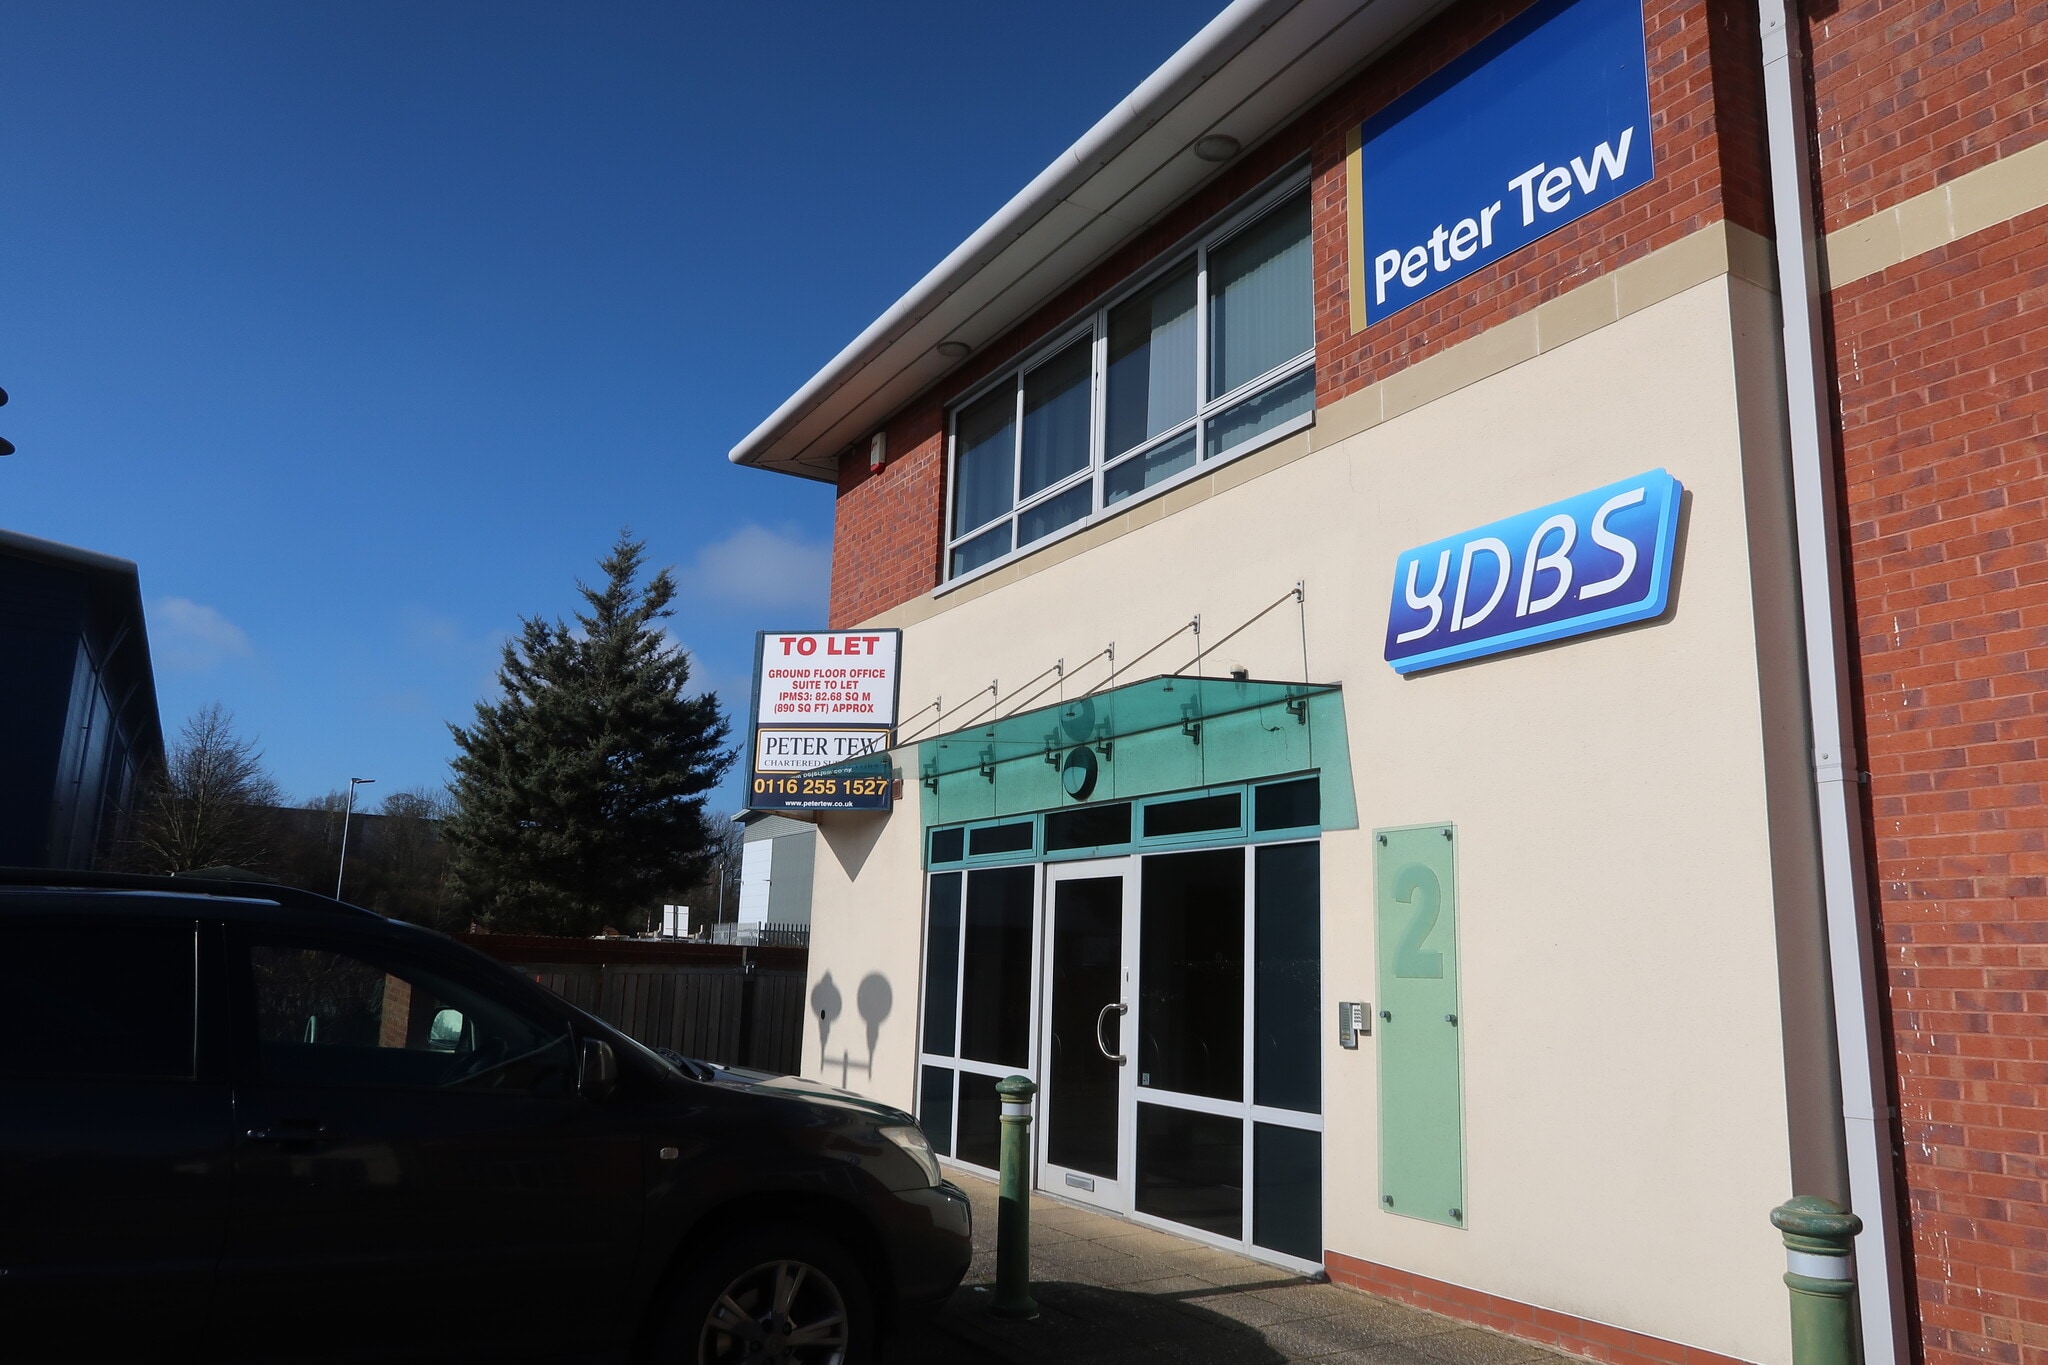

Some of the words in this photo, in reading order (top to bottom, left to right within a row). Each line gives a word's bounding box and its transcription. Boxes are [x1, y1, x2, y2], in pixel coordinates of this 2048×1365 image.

[1375, 200, 1500, 305] Peter
[1508, 126, 1634, 227] Tew
[1396, 487, 1645, 643] YDBS
[779, 637, 817, 656] TO
[827, 636, 880, 655] LET
[768, 669, 811, 679] GROUND
[814, 669, 847, 678] FLOOR
[849, 669, 886, 678] OFFICE
[792, 681, 821, 690] SUITE
[824, 681, 838, 690] TO
[840, 681, 859, 690] LET
[779, 692, 813, 701] IPMS3:
[815, 692, 842, 701] 82.68
[845, 692, 859, 702] SQ
[862, 692, 871, 701] M
[774, 704, 795, 714] (890
[797, 704, 811, 714] SQ
[814, 704, 829, 714] FT)
[832, 704, 874, 713] APPROX
[766, 737, 828, 756] PETER
[834, 737, 879, 756] TEW
[764, 759, 821, 767] CHARTERED
[754, 778, 798, 794] 0116
[802, 779, 836, 794] 255
[843, 779, 889, 795] 1527
[785, 800, 853, 808] www.petertew.co.uk
[1392, 862, 1443, 979] 2
